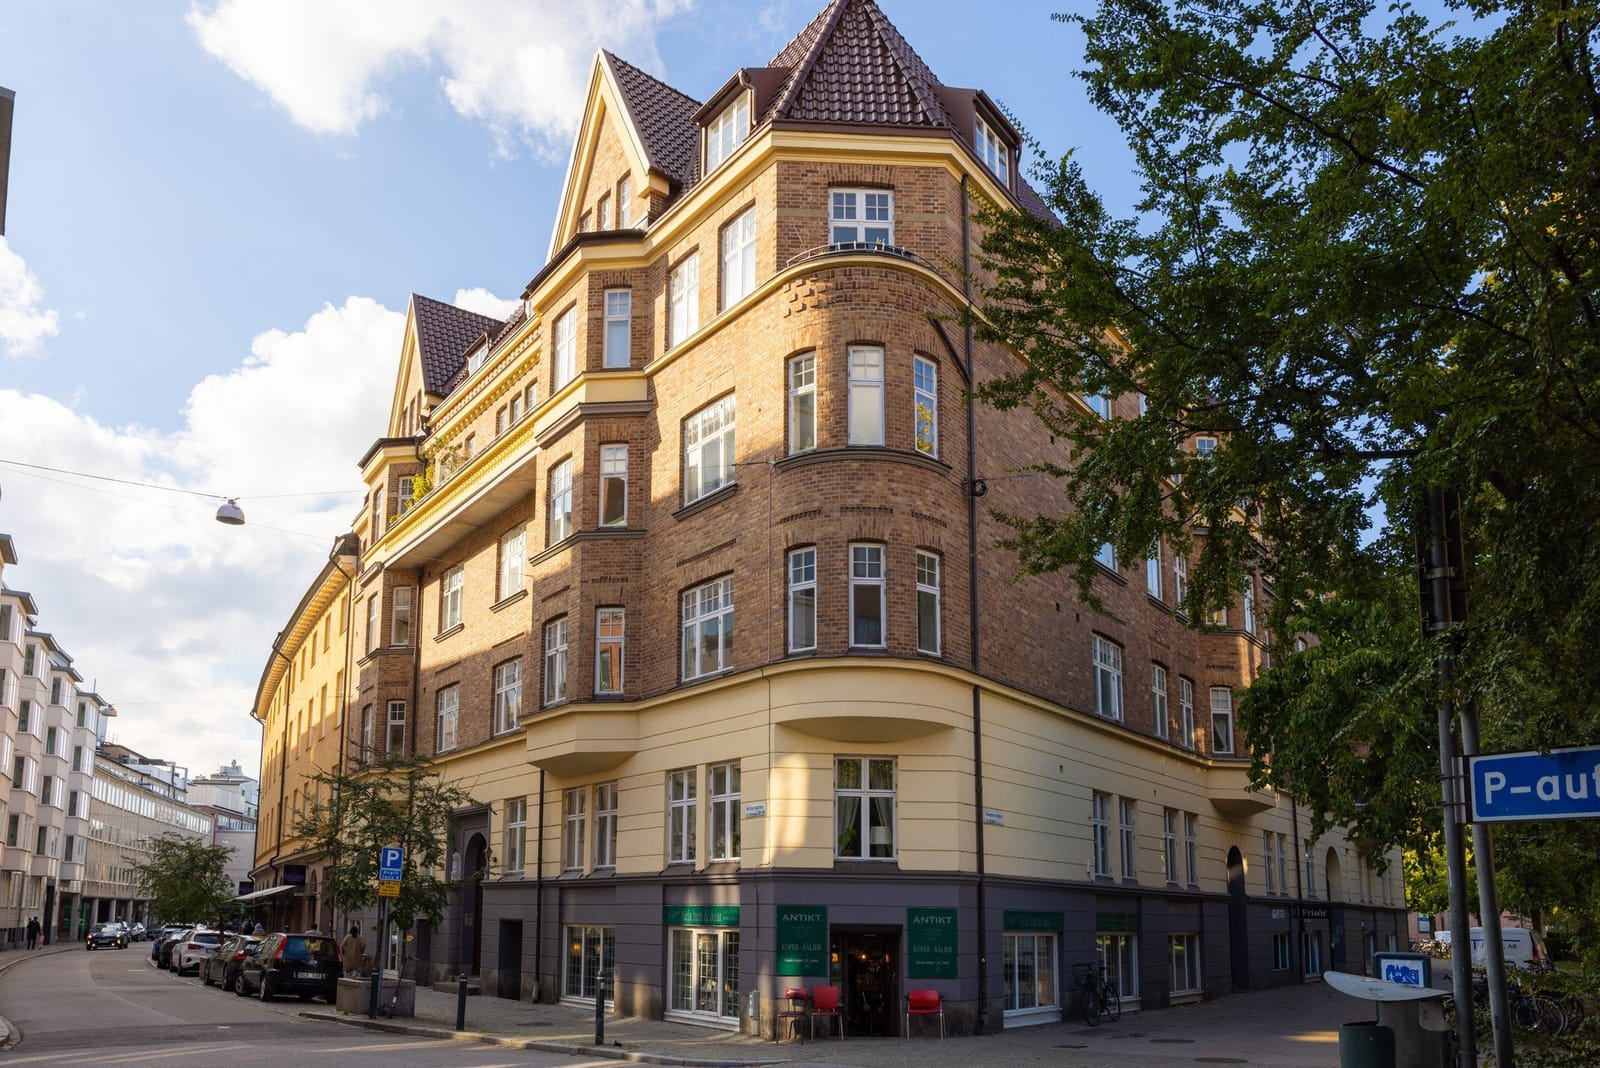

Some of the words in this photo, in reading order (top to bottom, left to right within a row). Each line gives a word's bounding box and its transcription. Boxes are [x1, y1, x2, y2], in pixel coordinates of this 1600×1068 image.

[386, 850, 399, 867] P
[782, 913, 822, 921] ANTIKT
[1302, 908, 1328, 917] Frisör
[913, 915, 953, 924] ANTIKT
